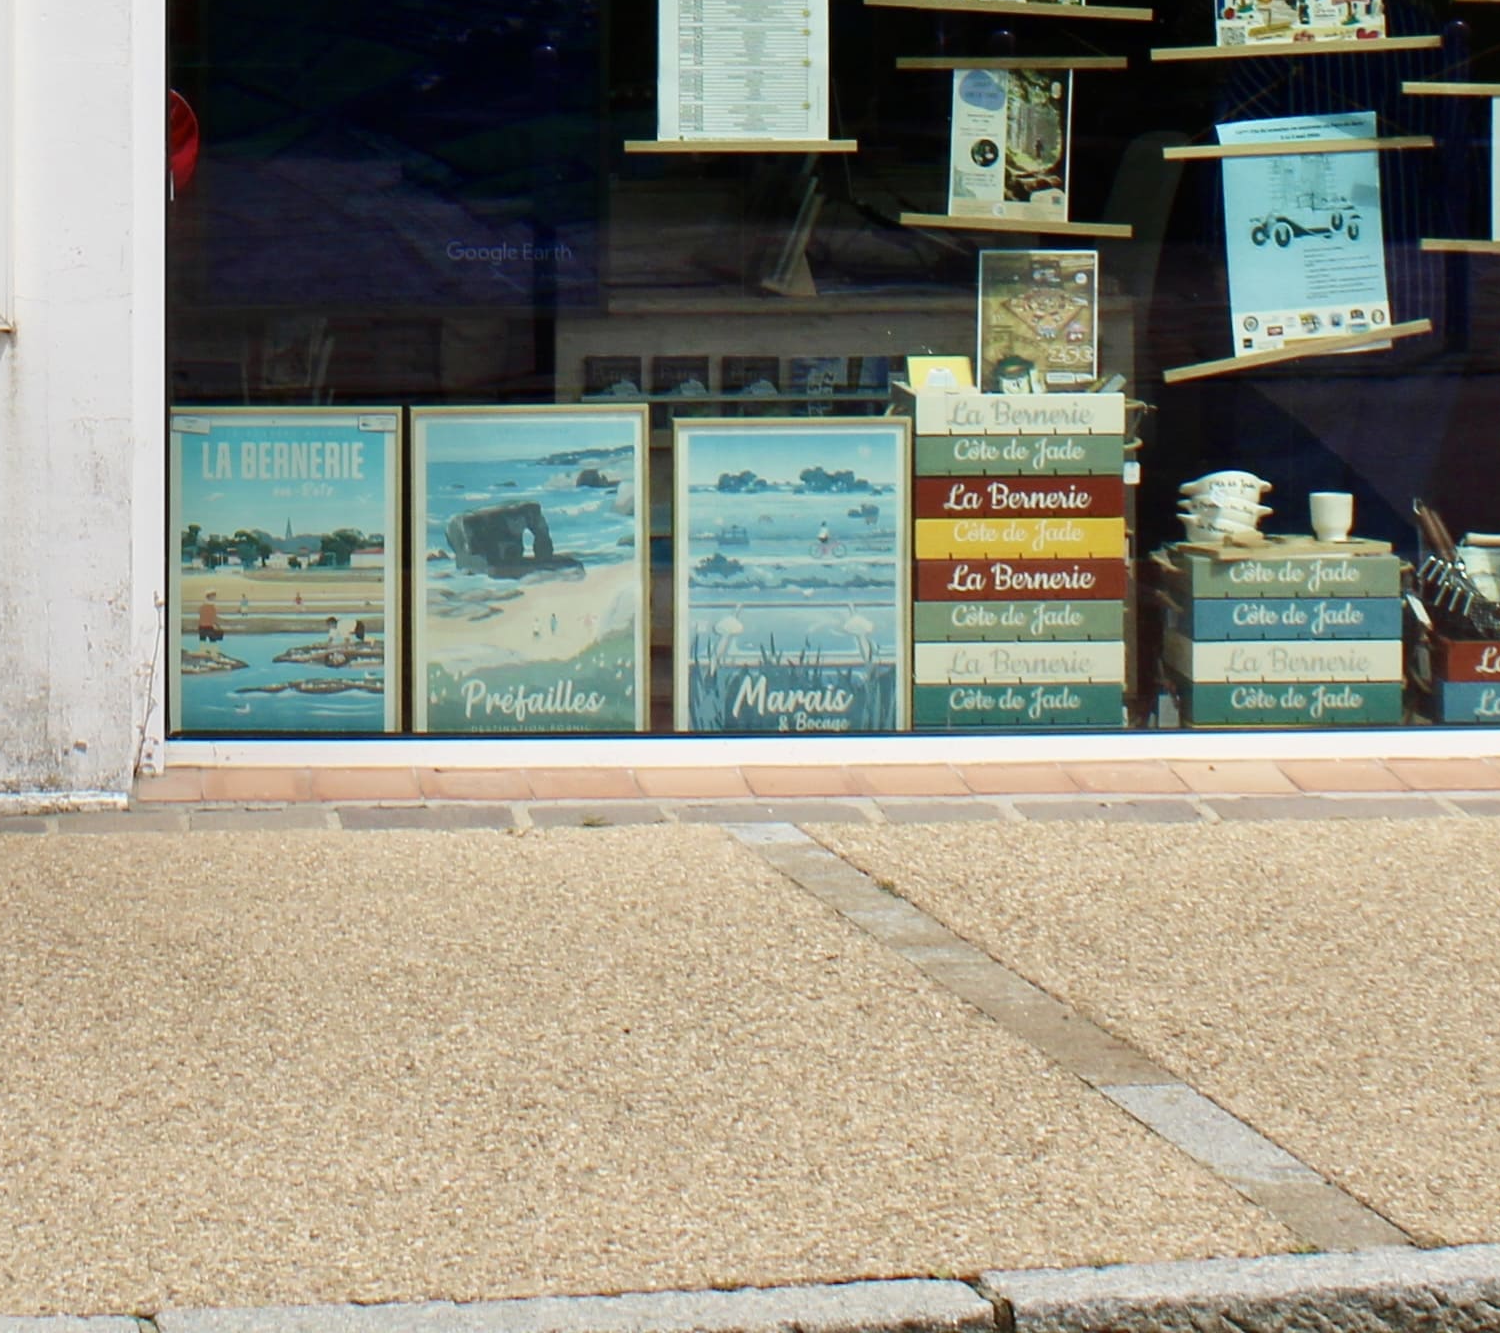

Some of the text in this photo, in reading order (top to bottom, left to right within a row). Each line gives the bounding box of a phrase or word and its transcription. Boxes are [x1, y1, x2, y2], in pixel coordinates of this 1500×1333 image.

[446, 240, 572, 266] Google Earth
[947, 399, 1094, 427] La Bernerie
[201, 441, 365, 480] LA BERNERIE
[954, 437, 1086, 470] Côte de Jade
[943, 481, 1091, 510] La Bernerie
[953, 519, 1084, 552] Côte de Jade
[947, 563, 1096, 592] La Bernerie
[1230, 559, 1360, 592] Côte de Jade
[951, 604, 1083, 637] Côte de Jade
[1232, 602, 1364, 636] Côte de Jade
[946, 648, 1094, 676] La Bernerie
[1224, 647, 1370, 674] La Bernerie
[461, 678, 606, 722] Préfailles
[732, 674, 854, 718] Marais
[949, 685, 1080, 719] Côte de Jade
[1230, 686, 1363, 719] Côte de Jade
[778, 715, 789, 732] &
